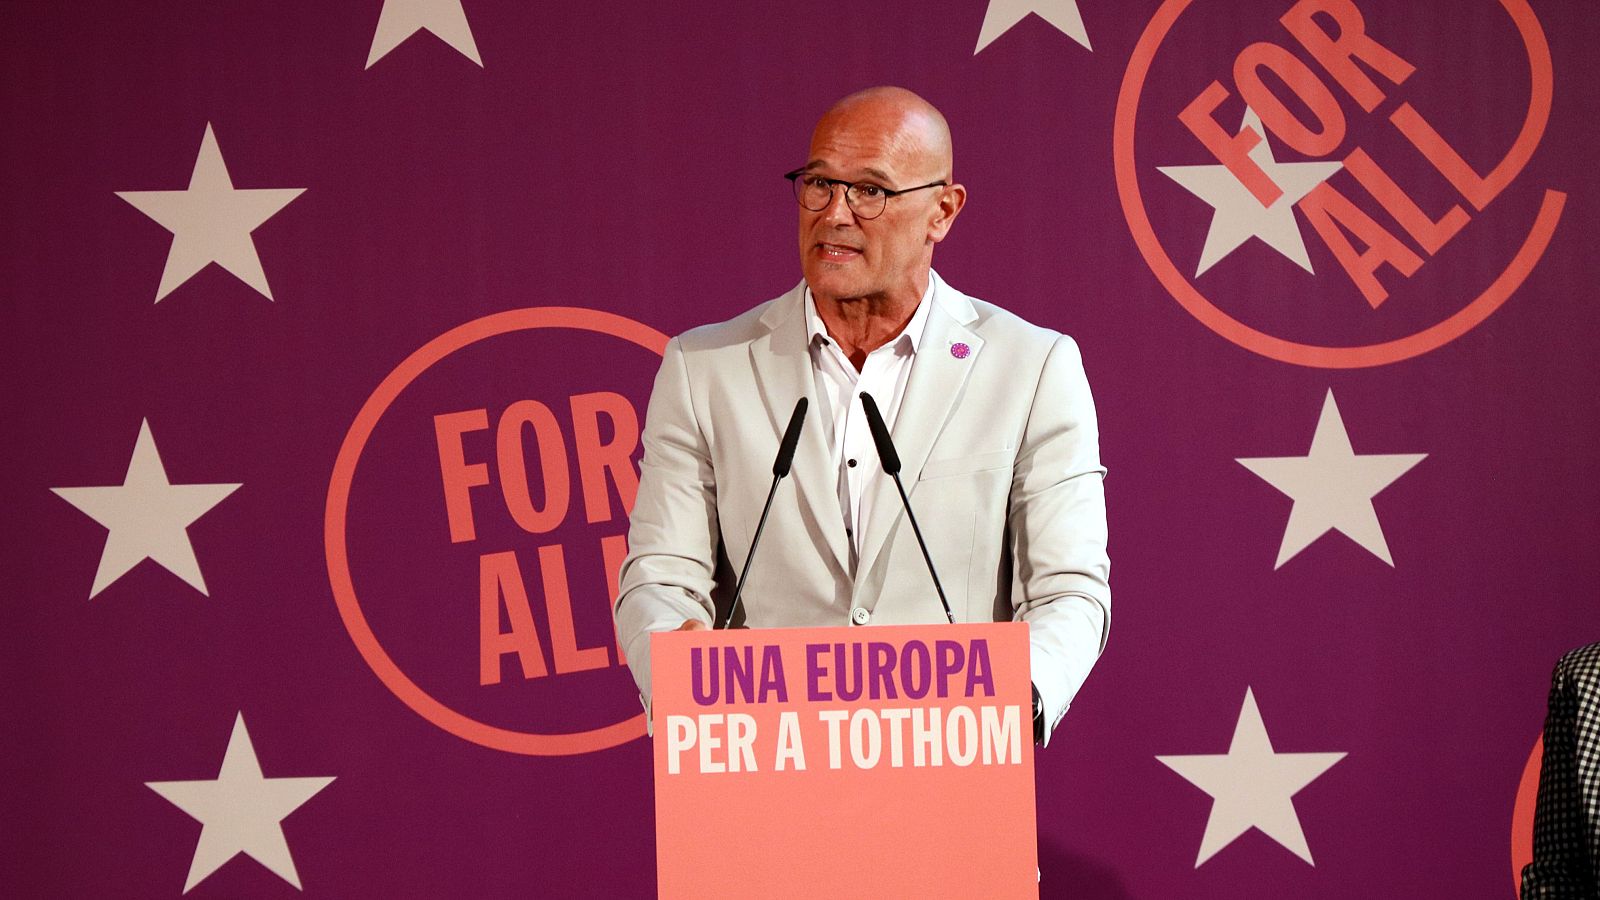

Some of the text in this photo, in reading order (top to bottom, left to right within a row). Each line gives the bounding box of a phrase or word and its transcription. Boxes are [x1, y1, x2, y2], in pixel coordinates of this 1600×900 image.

[1177, 0, 1417, 210] FOR
[1298, 101, 1504, 310] ALL
[433, 391, 640, 544] FOR
[666, 704, 1023, 775] PER A TOTHOM
[690, 638, 996, 707] UNA EUROPA
